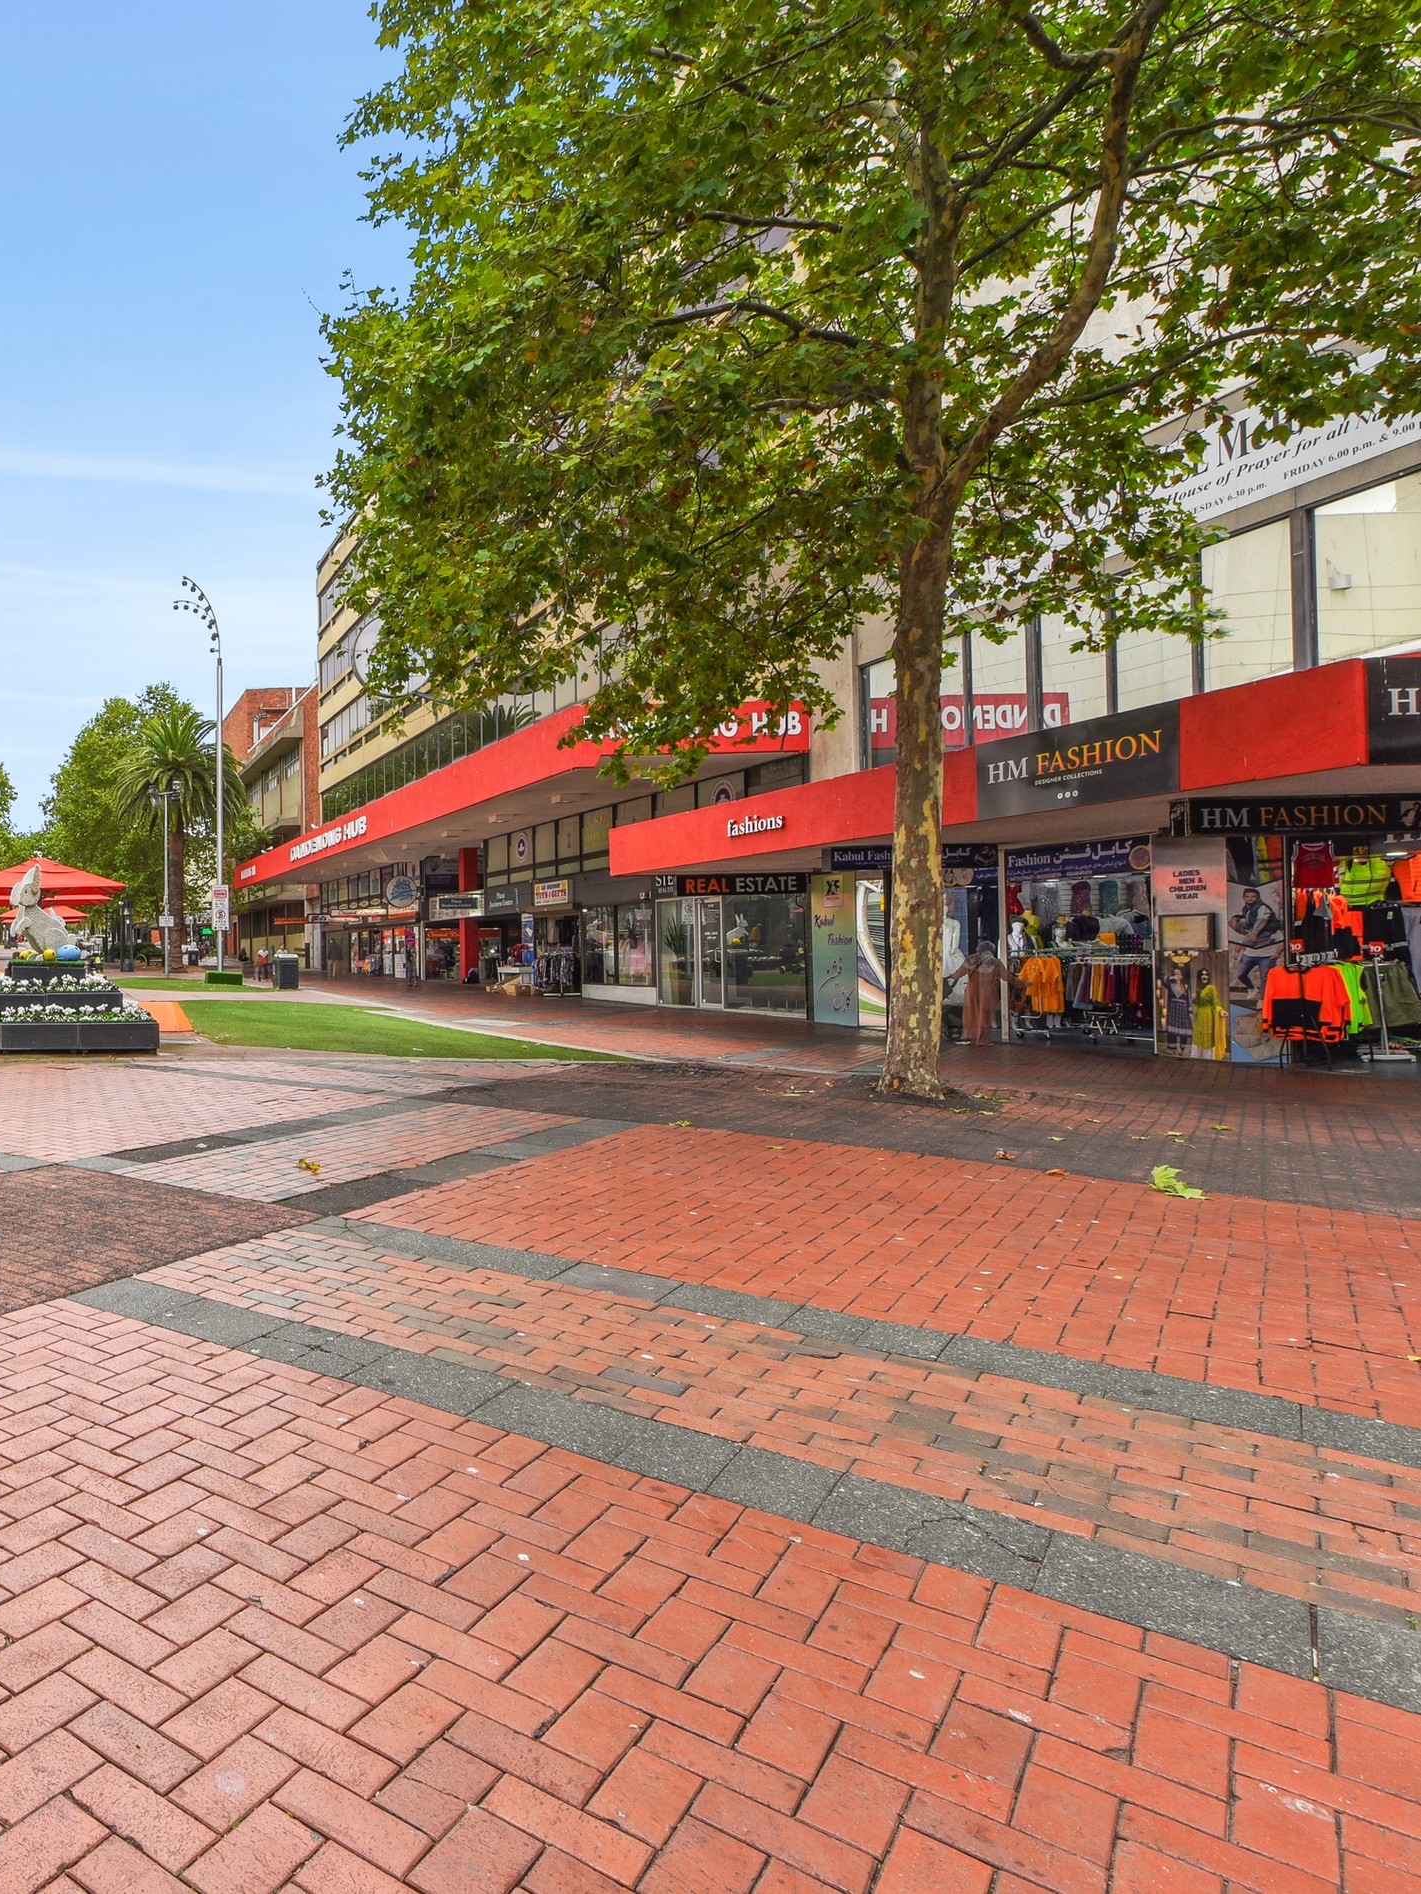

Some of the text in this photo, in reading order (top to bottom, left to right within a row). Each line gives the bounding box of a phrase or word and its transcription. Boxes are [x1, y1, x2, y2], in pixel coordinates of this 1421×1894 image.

[1167, 480, 1212, 503] House
[1216, 468, 1234, 487] of
[1236, 451, 1291, 479] Prayer
[1292, 434, 1322, 459] for
[1326, 420, 1351, 441] all
[1227, 488, 1246, 502] 6.30
[1247, 481, 1268, 497] p.m.
[1283, 455, 1327, 480] FRIDAY
[1328, 448, 1349, 463] 6.00
[1352, 440, 1376, 456] p.m.
[1379, 433, 1388, 442] &
[1392, 422, 1415, 437] 9.00
[987, 729, 1162, 785] HM FASHION
[1034, 769, 1103, 786] DESIGNER COLLECTIONS
[1200, 804, 1388, 829] HM FASHION
[726, 814, 783, 838] fashions
[290, 816, 367, 862] DANDENONG HUB
[834, 850, 890, 862] Kabul Fash
[1008, 853, 1051, 868] Fashion
[536, 890, 548, 899] TOYS
[552, 888, 567, 897] GIFTS
[685, 876, 797, 894] REAL ESTATE
[814, 914, 835, 929] Kabul
[827, 933, 852, 946] Fashion
